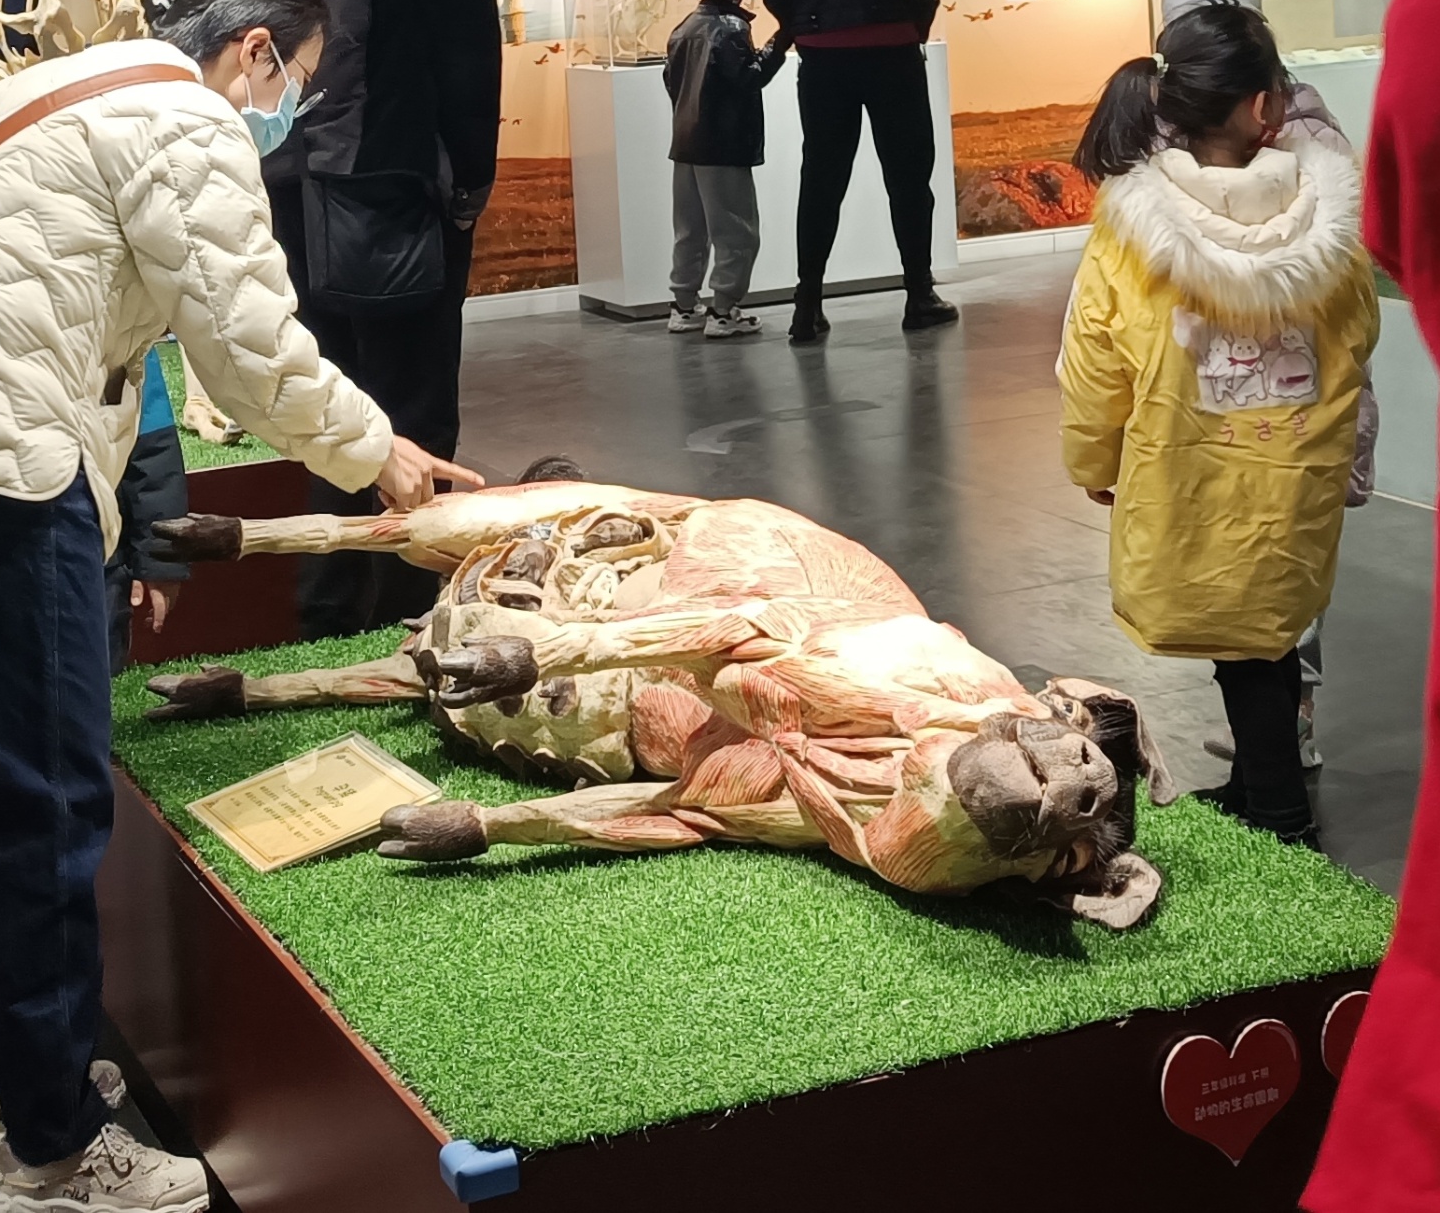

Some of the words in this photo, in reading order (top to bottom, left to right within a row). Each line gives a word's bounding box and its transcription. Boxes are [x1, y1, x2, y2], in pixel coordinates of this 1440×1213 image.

[1219, 412, 1309, 444] うさぎ
[1194, 1087, 1280, 1122] 动物的生命周期
